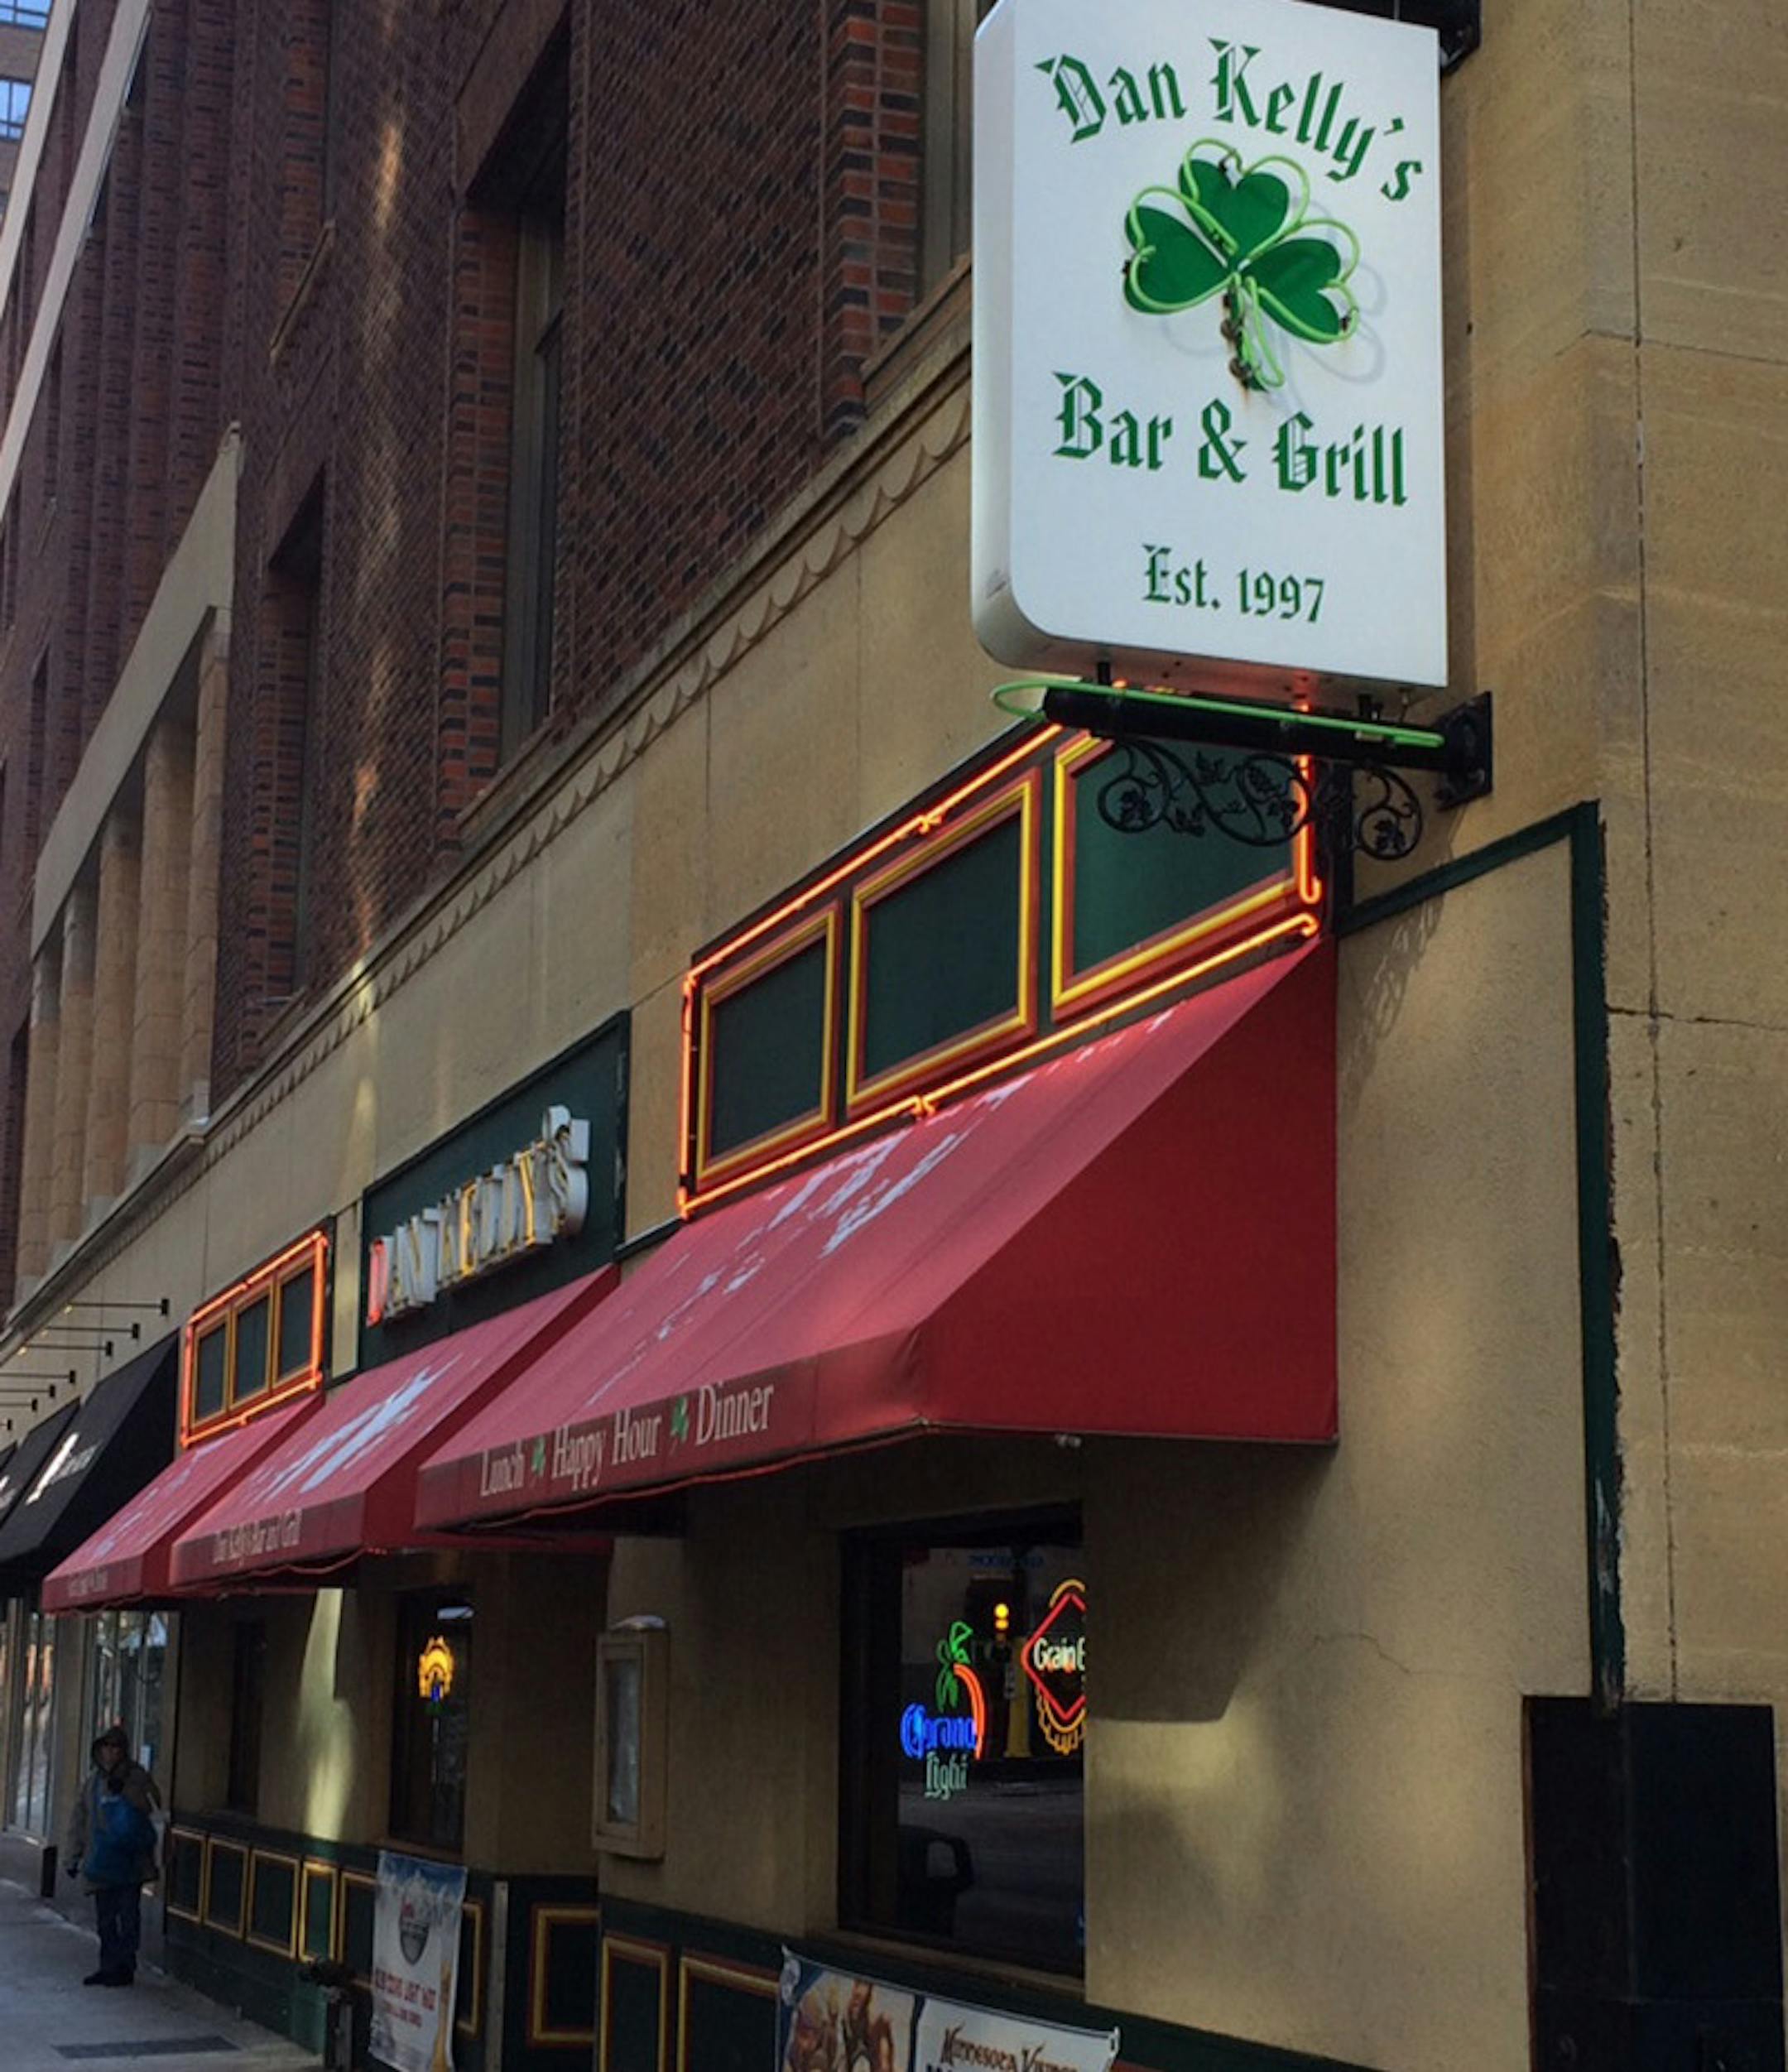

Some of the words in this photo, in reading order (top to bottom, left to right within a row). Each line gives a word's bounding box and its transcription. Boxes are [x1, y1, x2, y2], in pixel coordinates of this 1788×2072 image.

[1034, 54, 1186, 144] Dan
[1209, 38, 1422, 201] Kelly's
[1051, 371, 1173, 471] Bar
[1198, 398, 1247, 483] &
[1274, 411, 1409, 507] Grill
[1142, 545, 1221, 609] Est.
[1238, 570, 1325, 623] 1997
[480, 1439, 525, 1497] Lunch
[551, 1423, 605, 1492] Happy
[612, 1409, 661, 1465] Hour
[695, 1382, 774, 1446] Dinner
